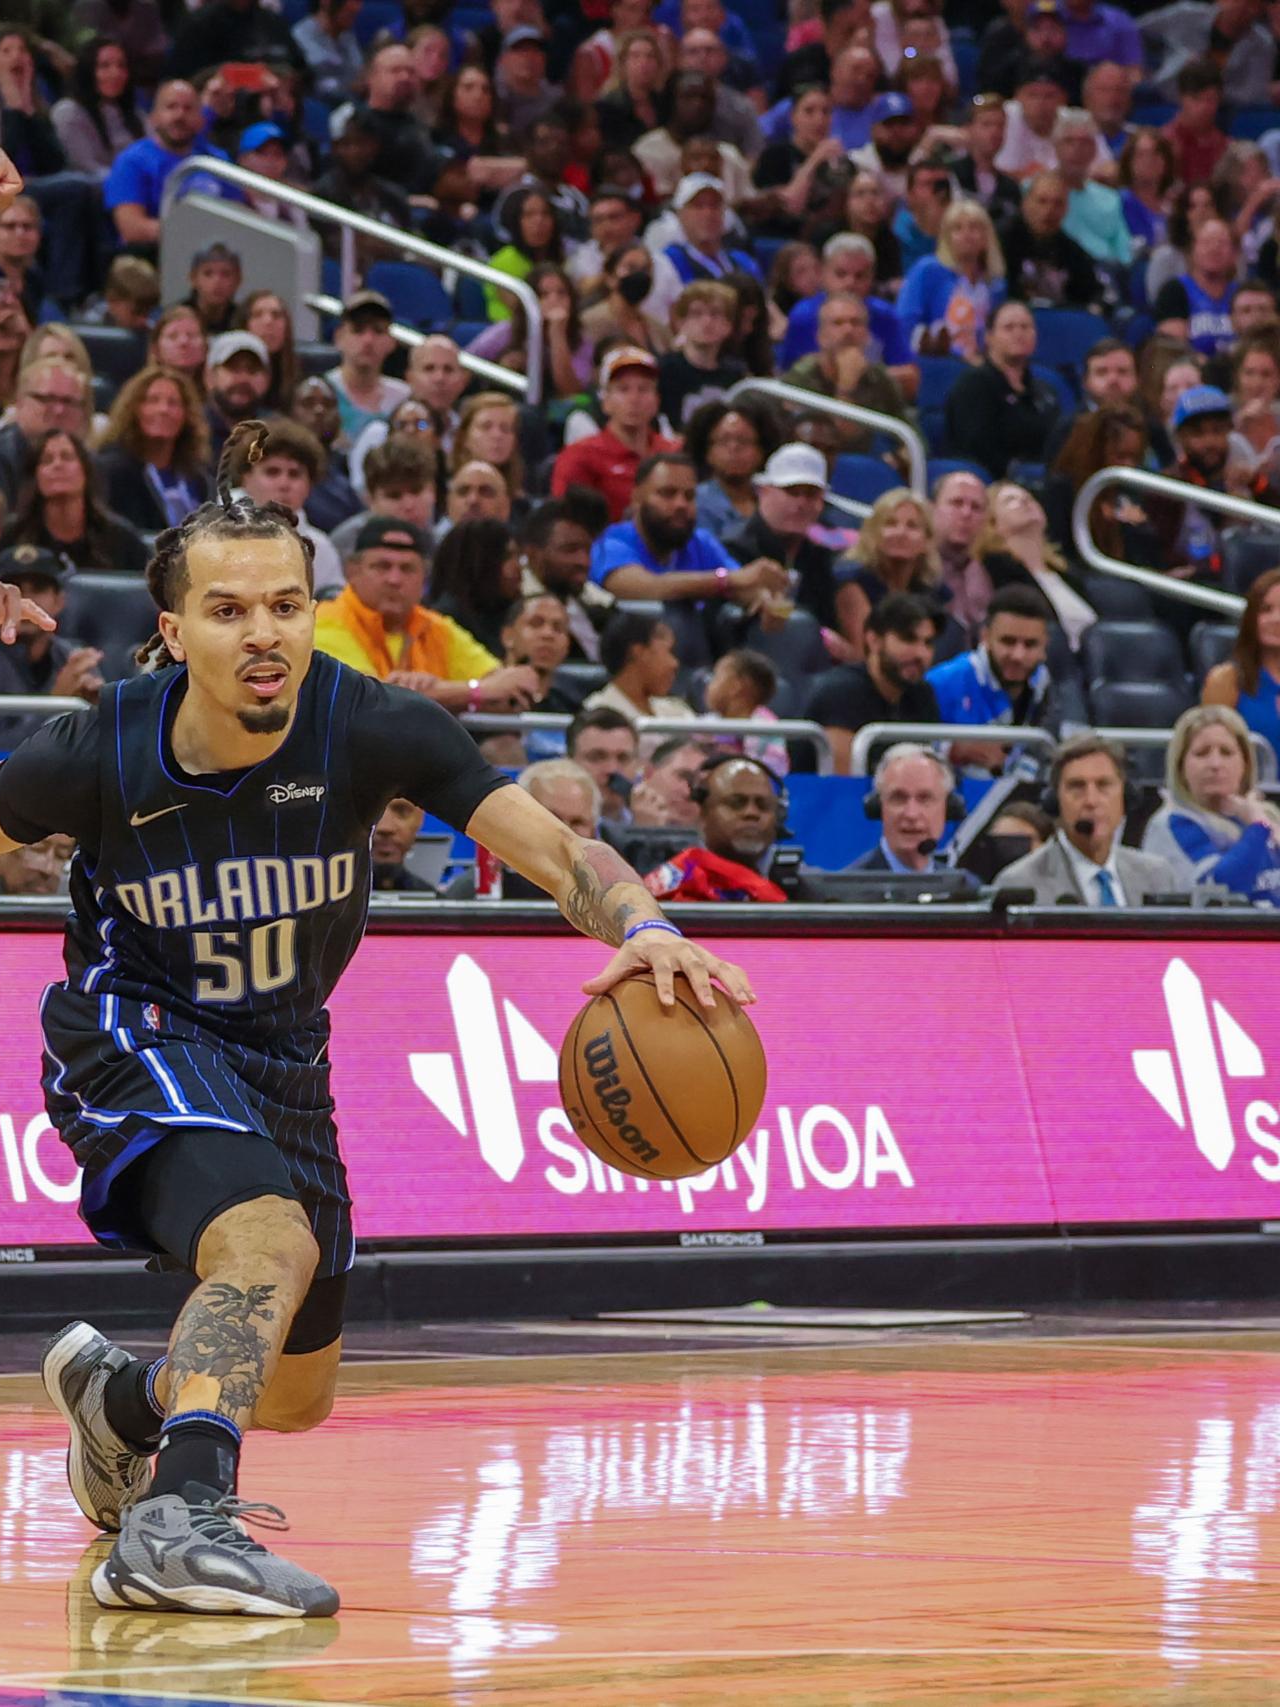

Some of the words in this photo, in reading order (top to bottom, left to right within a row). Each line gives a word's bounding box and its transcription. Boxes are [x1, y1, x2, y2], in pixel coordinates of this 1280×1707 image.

[265, 782, 325, 804] Disney
[115, 852, 356, 929] ORLANDO
[192, 917, 297, 1004] 50
[583, 1028, 661, 1164] Wilson
[776, 1104, 915, 1190] IOA
